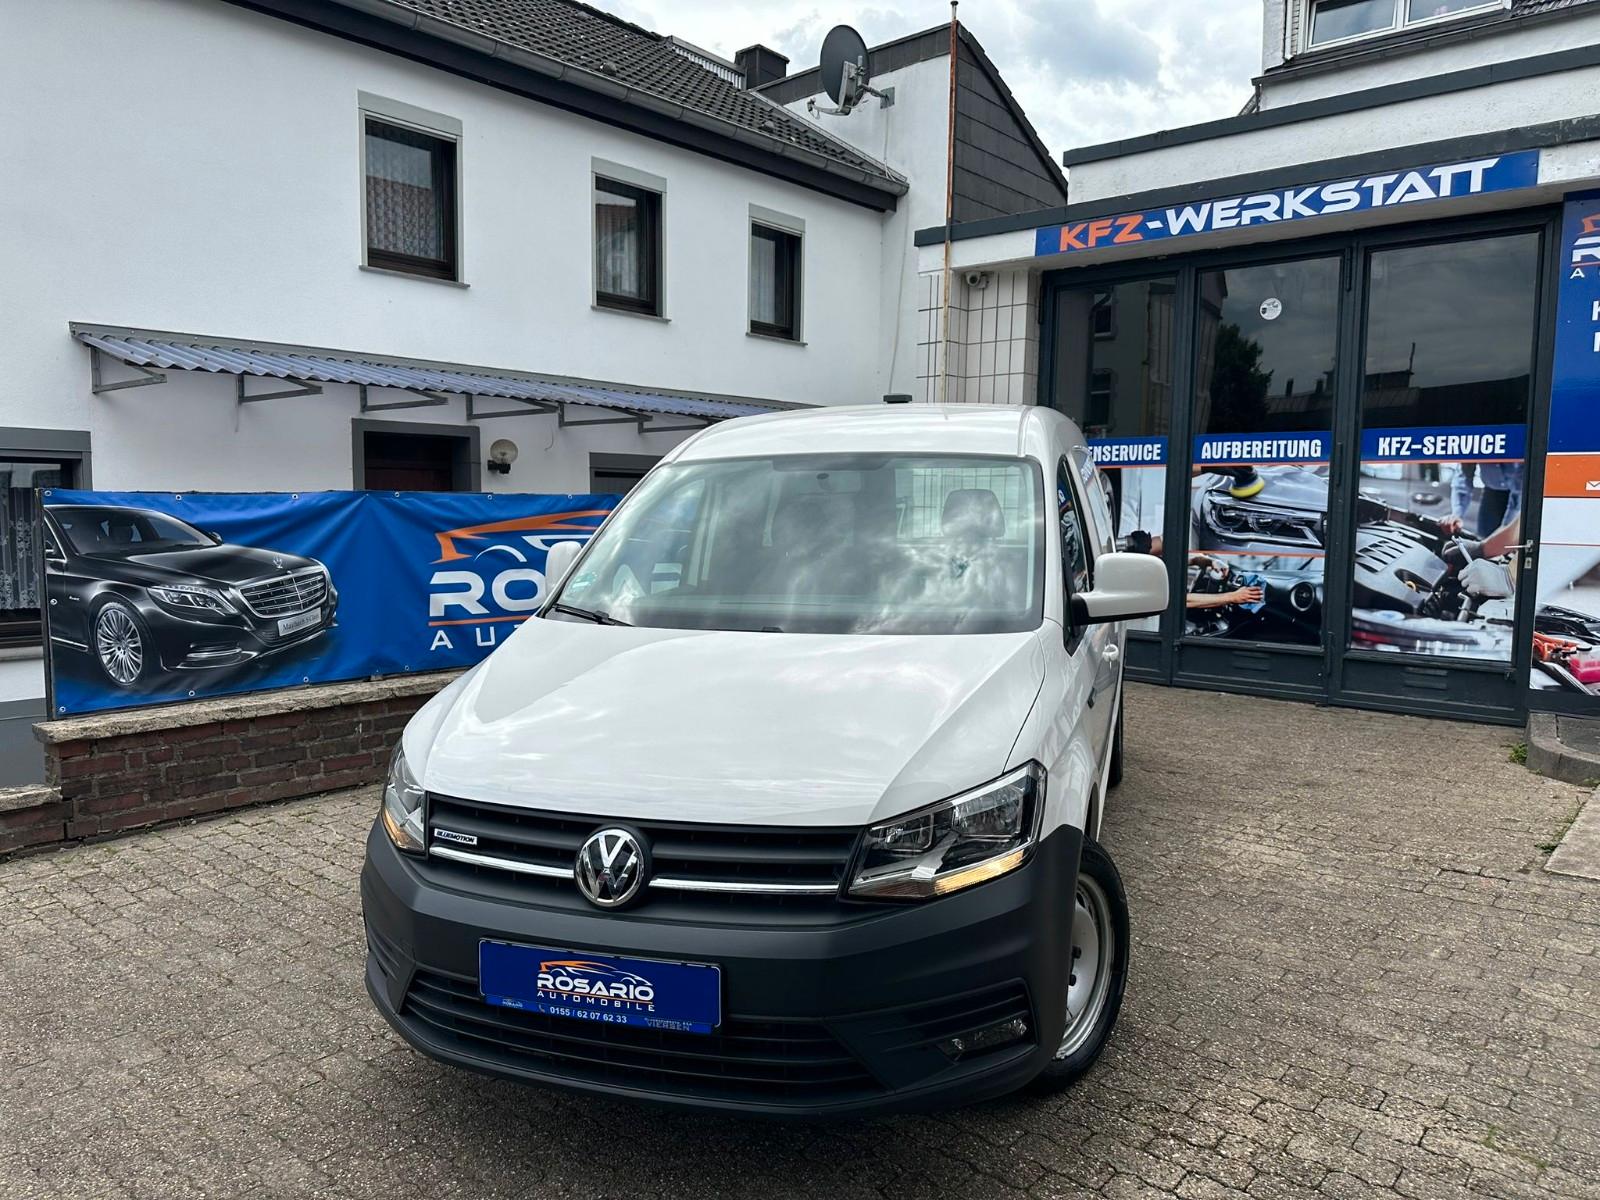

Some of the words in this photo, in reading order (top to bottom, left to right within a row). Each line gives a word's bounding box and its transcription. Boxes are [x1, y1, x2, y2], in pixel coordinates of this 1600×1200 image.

[1059, 158, 1500, 252] KFZ-WERKSTATT
[1201, 439, 1321, 459] AUFBEREITUNG
[1378, 434, 1506, 456] KFZ-SERVICE
[537, 973, 654, 1001] ROSARIO
[536, 990, 655, 1012] AUTOMOBILE
[549, 1006, 571, 1016] 0155
[577, 1010, 589, 1018] 62
[589, 1012, 601, 1020] 07
[603, 1014, 615, 1022] 62
[616, 1015, 628, 1024] 33
